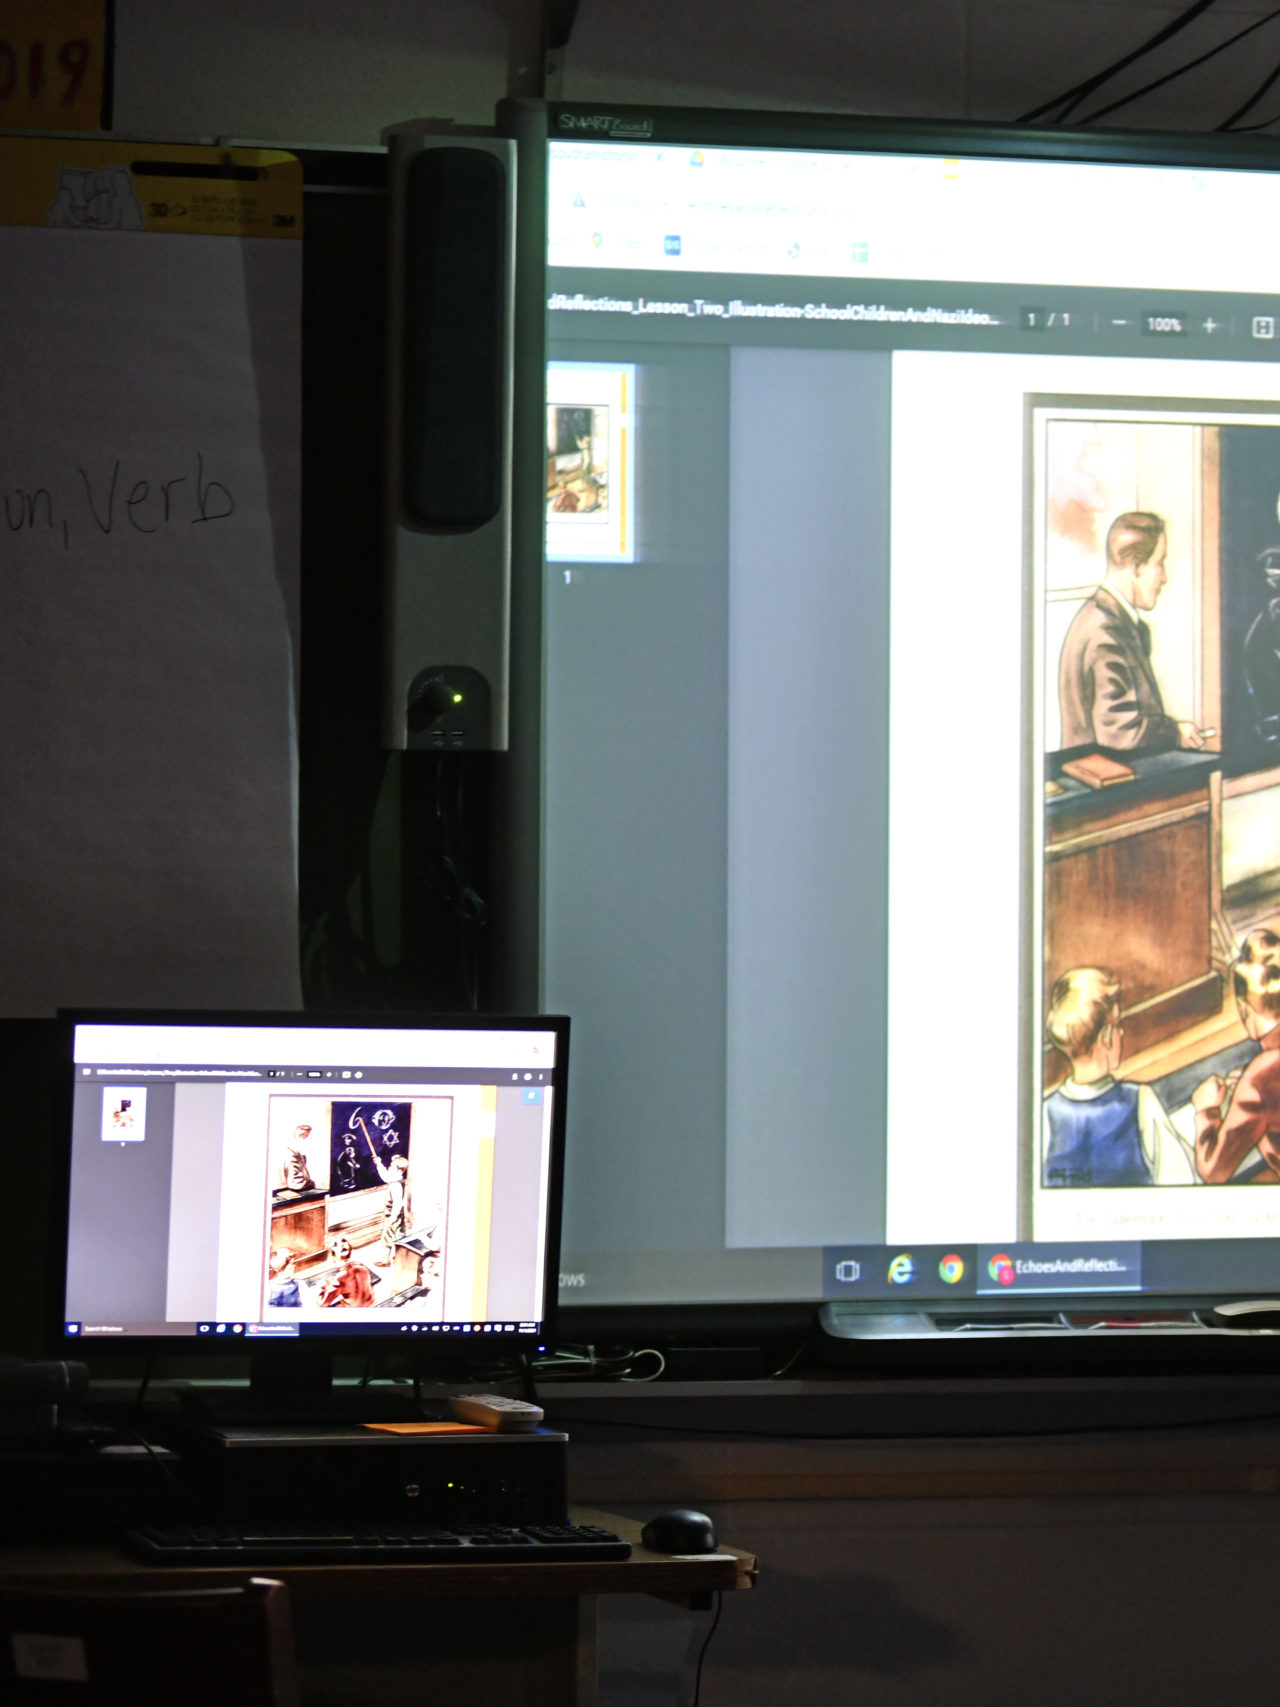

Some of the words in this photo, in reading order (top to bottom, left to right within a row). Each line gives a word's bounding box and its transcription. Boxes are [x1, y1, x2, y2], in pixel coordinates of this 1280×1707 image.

[559, 113, 614, 130] SMART
[149, 202, 169, 218] 30
[272, 214, 296, 228] 3M
[1027, 312, 1036, 327] 1
[1062, 312, 1071, 327] 1
[1148, 316, 1183, 332] 100%
[78, 452, 234, 534] Verb
